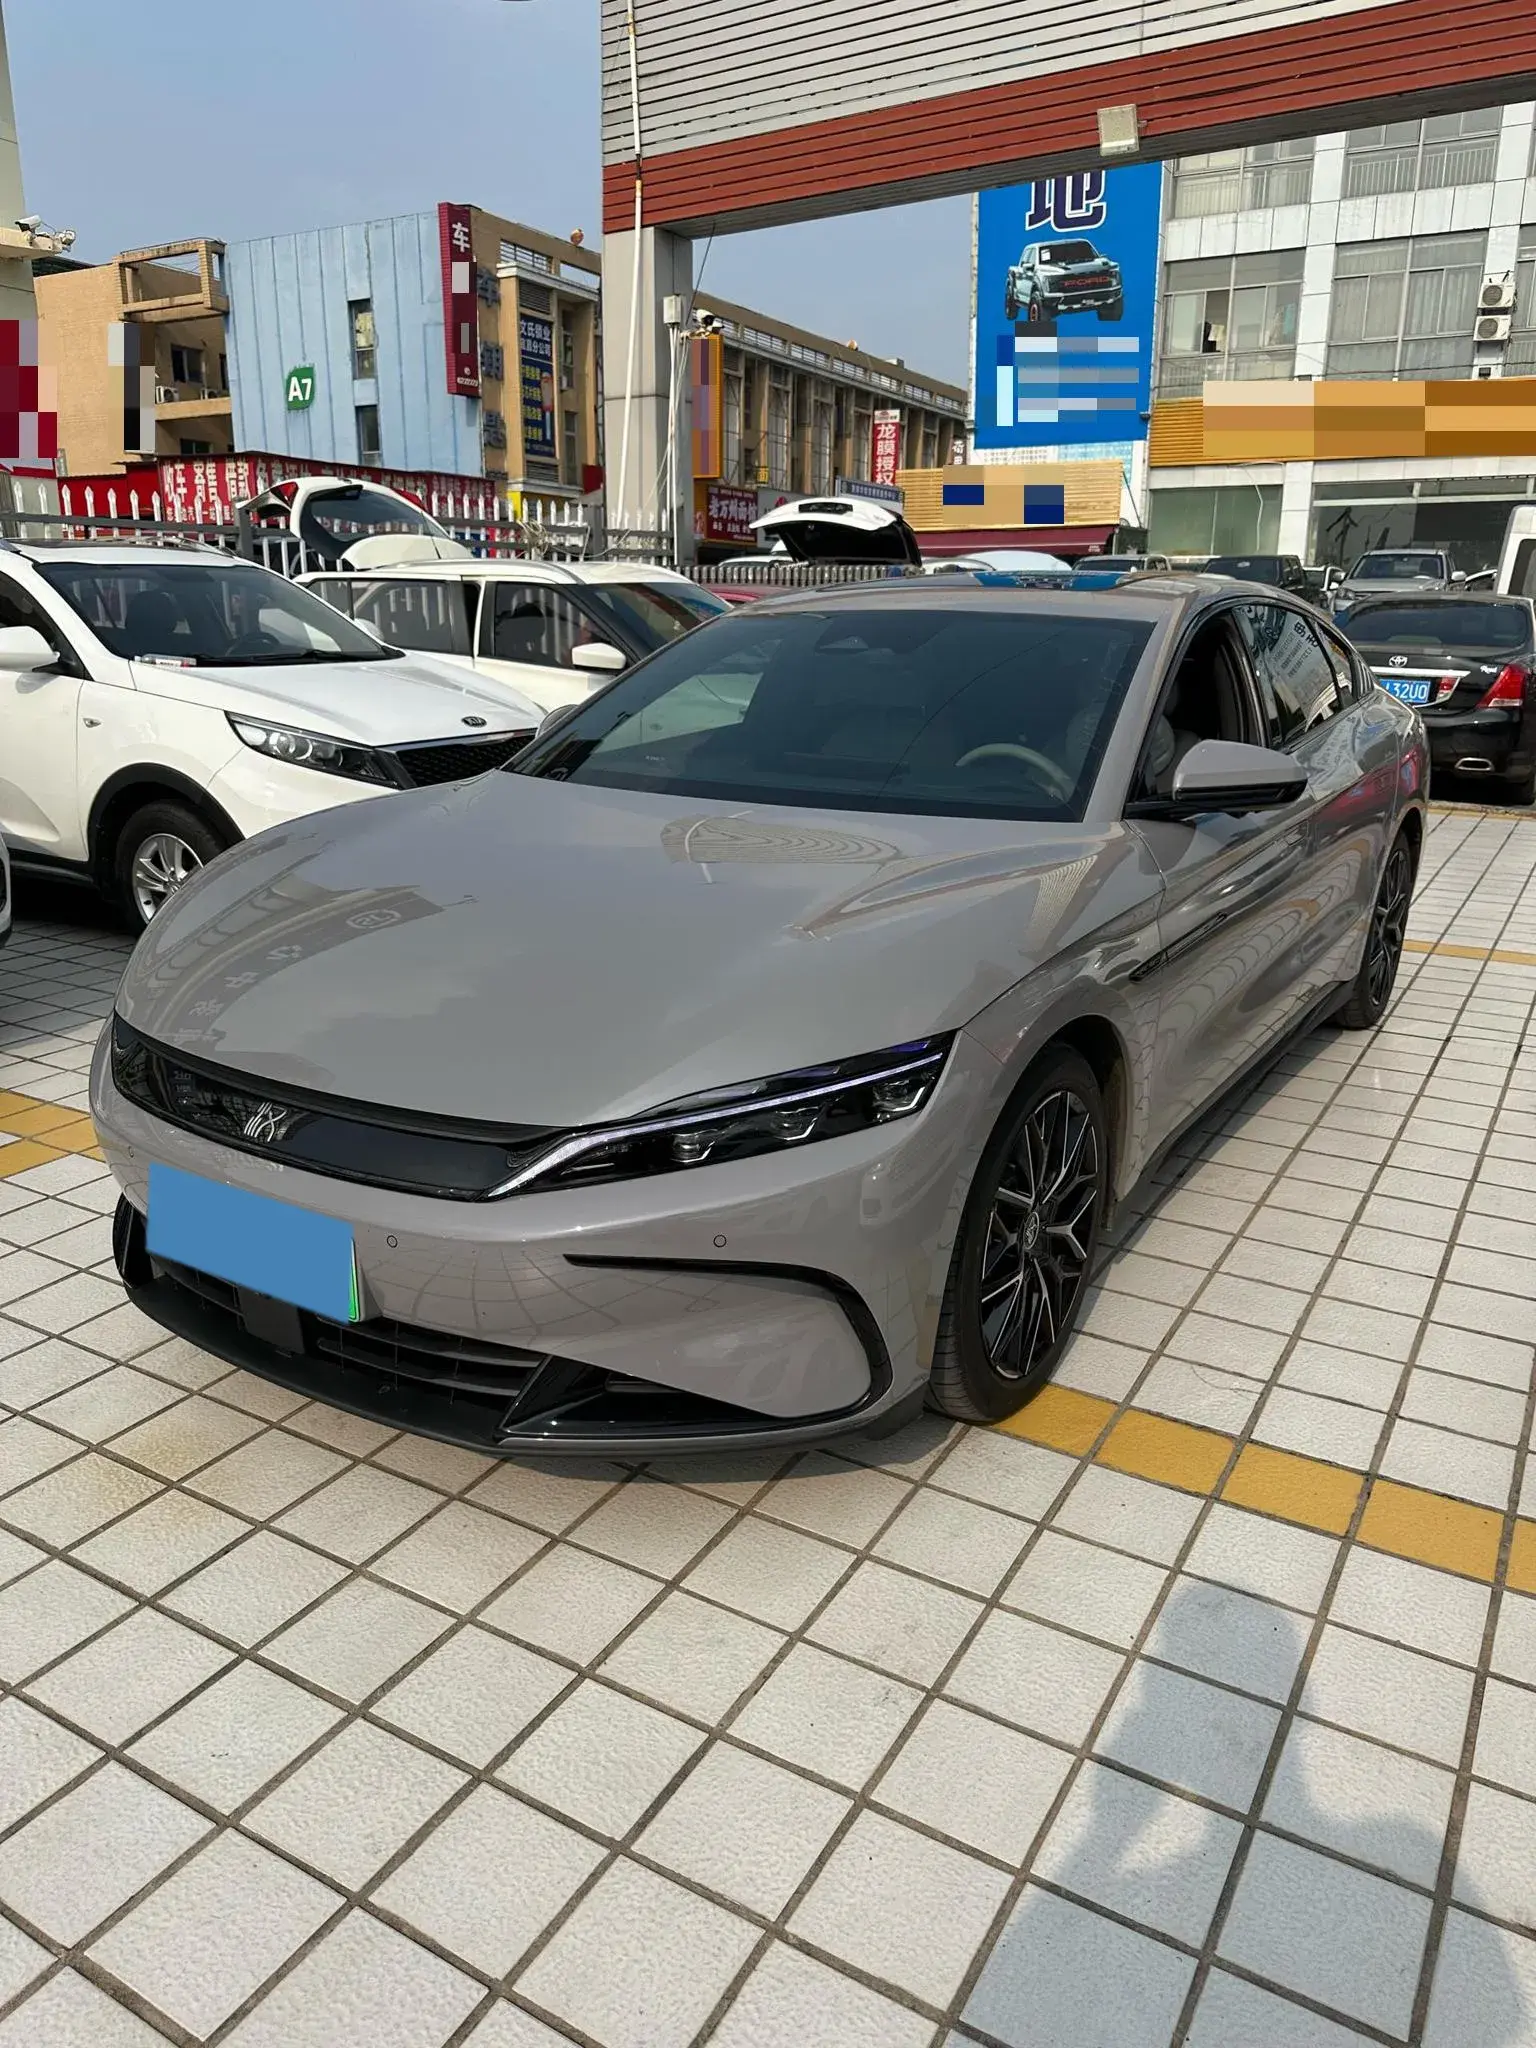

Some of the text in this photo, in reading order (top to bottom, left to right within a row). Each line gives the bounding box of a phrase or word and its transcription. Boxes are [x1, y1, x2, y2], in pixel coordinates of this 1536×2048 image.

[451, 222, 471, 253] 车
[1064, 275, 1109, 287] FORD
[288, 375, 312, 402] A7
[875, 423, 897, 486] 龙膜授权
